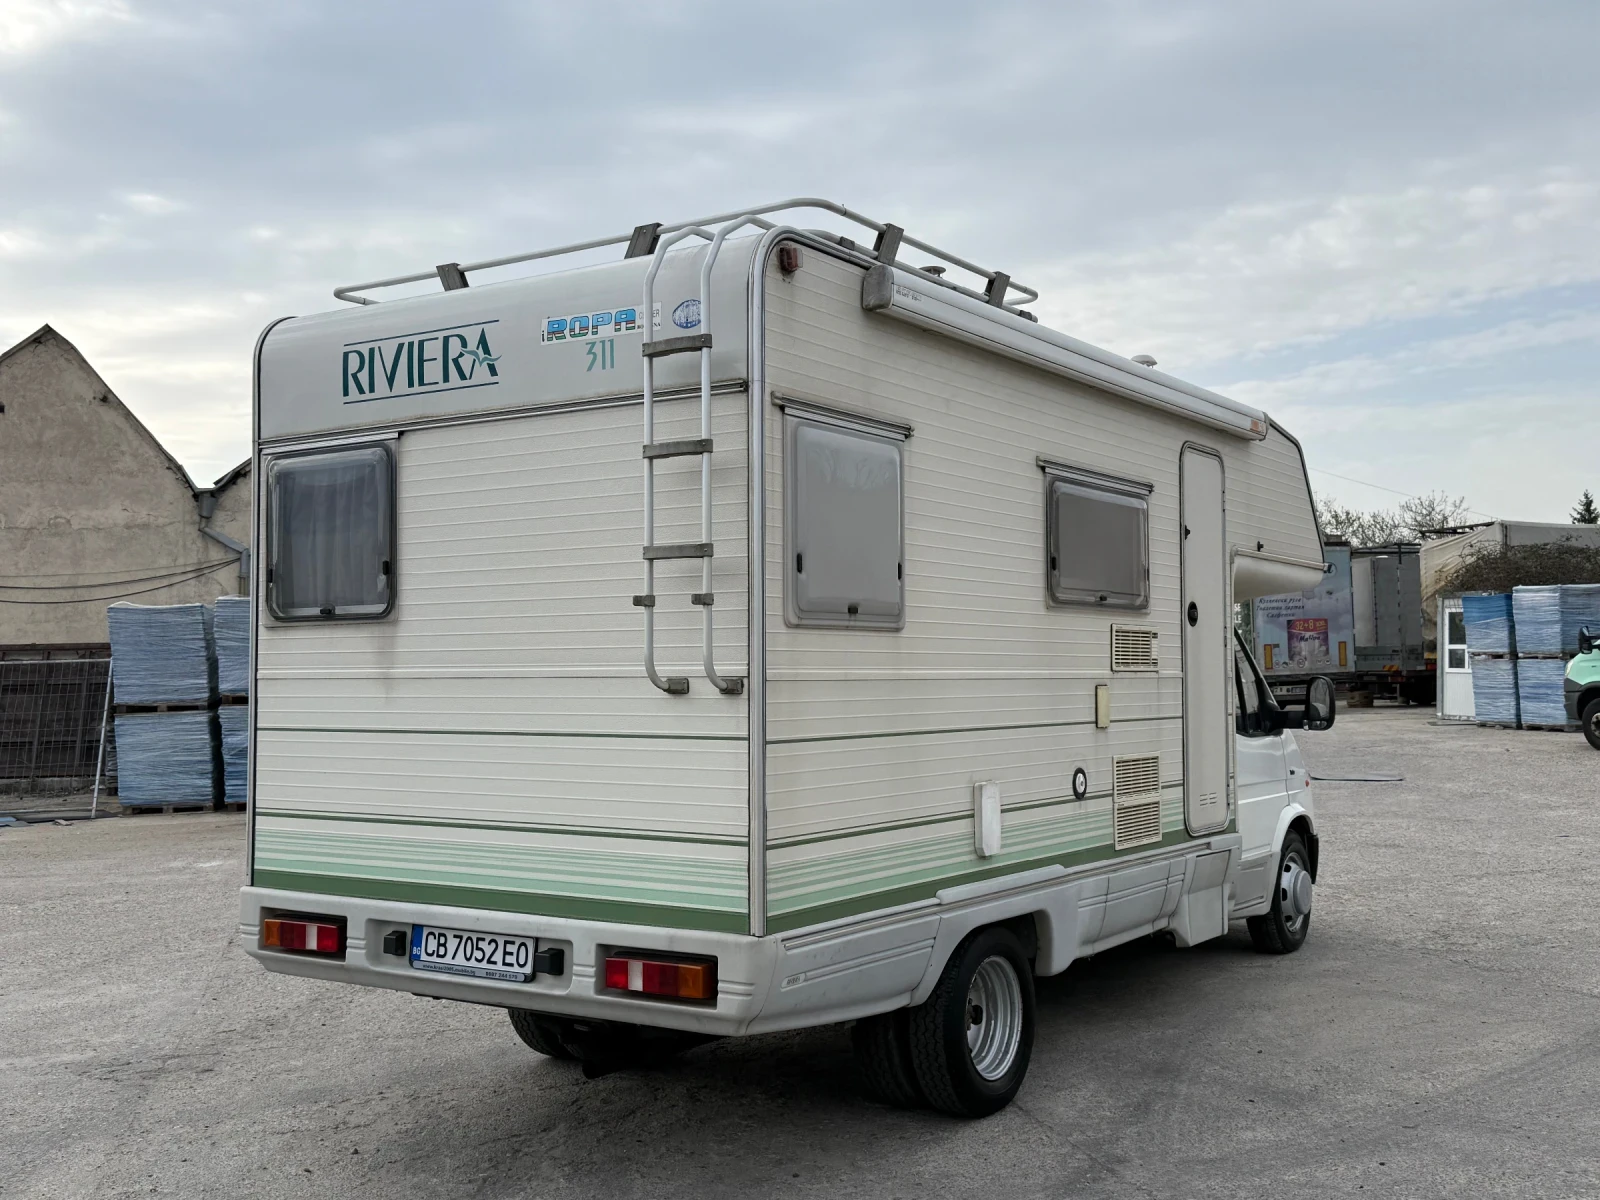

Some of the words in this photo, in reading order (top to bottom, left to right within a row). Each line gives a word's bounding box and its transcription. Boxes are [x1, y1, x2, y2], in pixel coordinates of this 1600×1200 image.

[342, 327, 500, 397] RIVIERA
[585, 338, 615, 372] 311
[412, 946, 421, 955] BG
